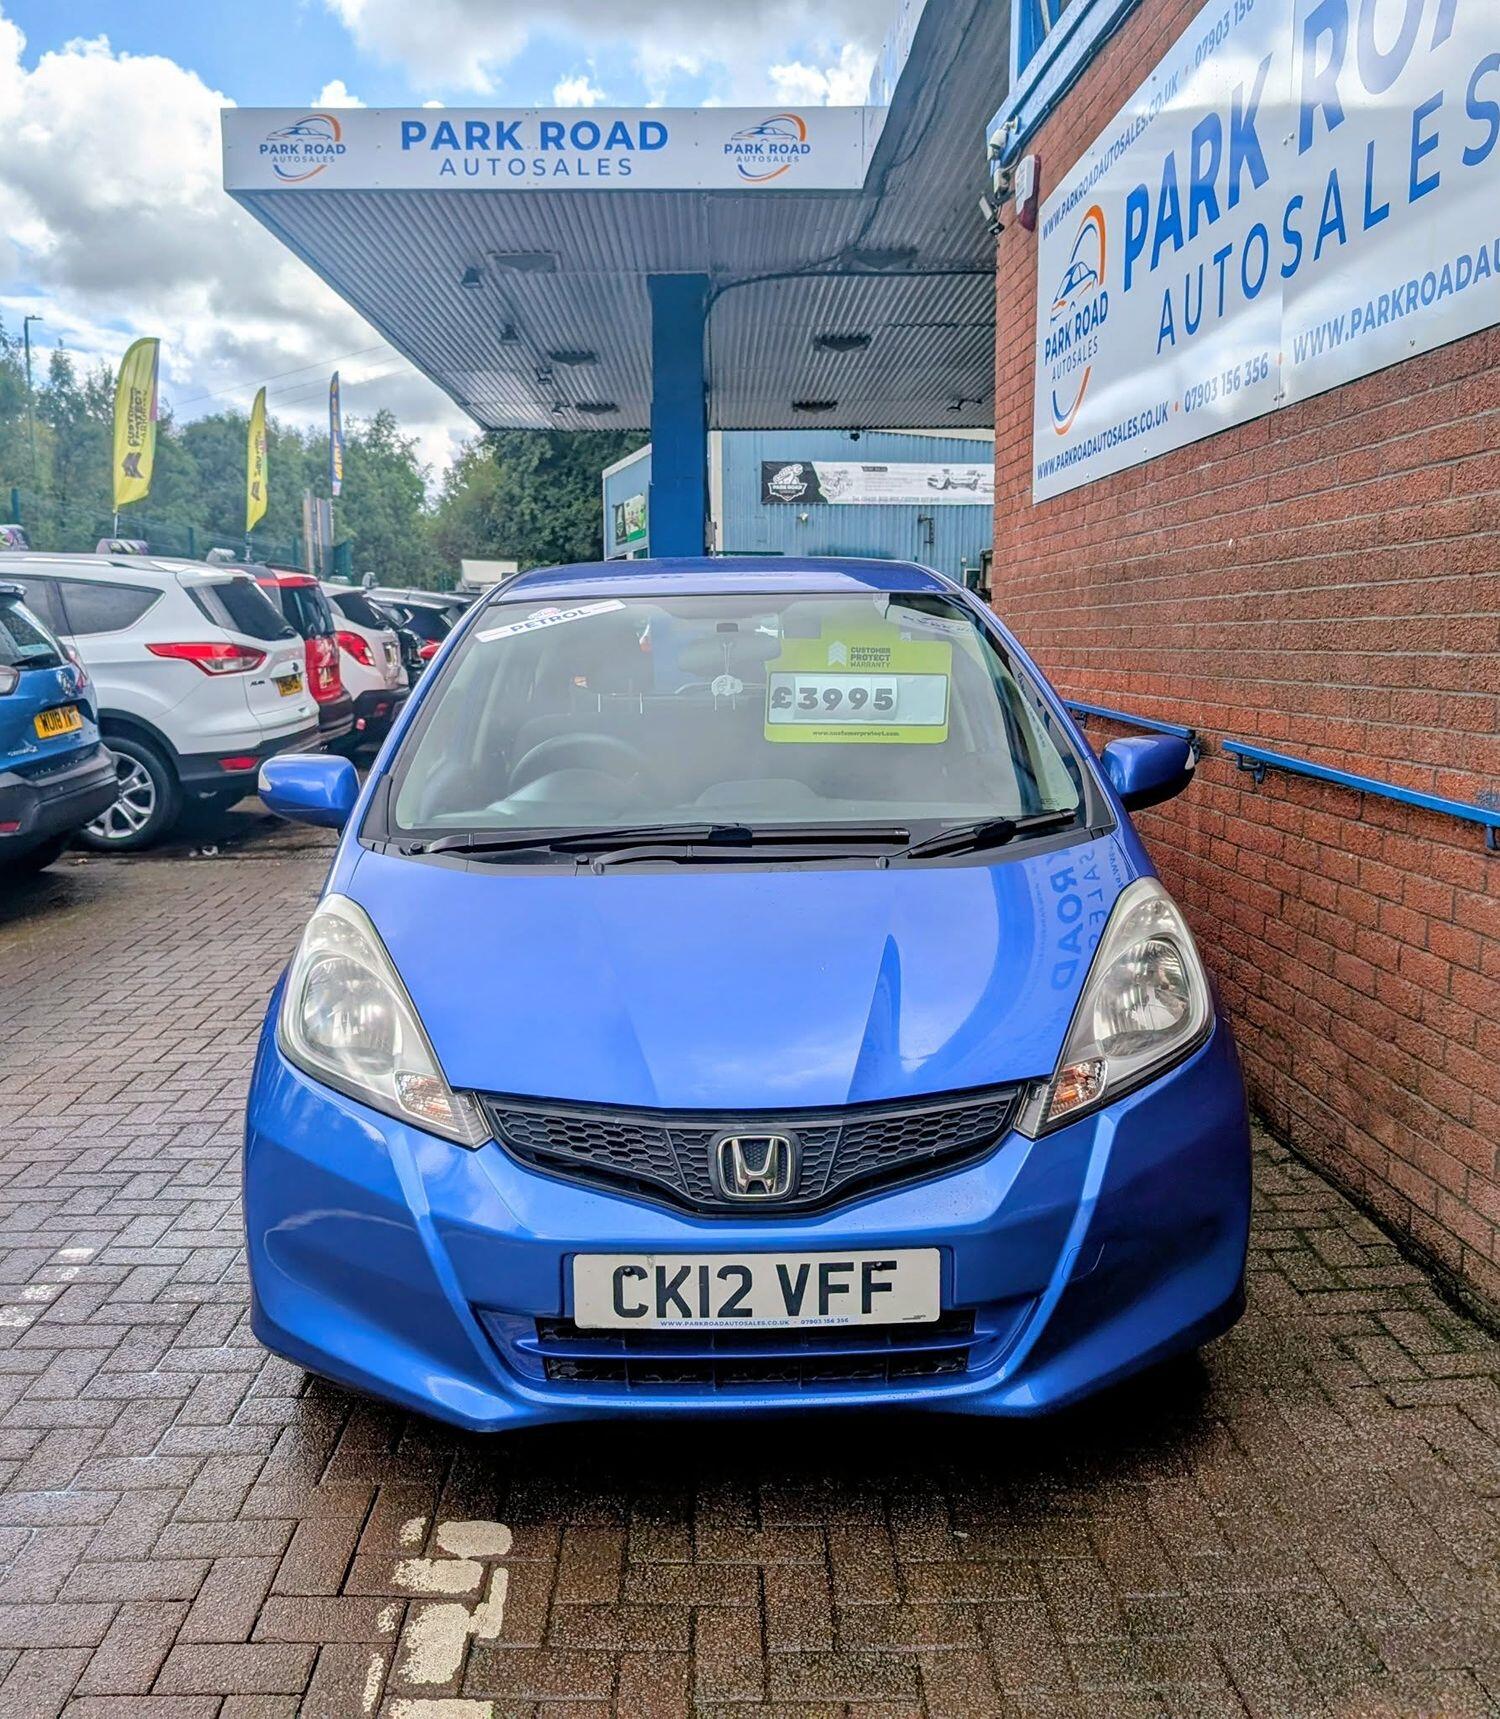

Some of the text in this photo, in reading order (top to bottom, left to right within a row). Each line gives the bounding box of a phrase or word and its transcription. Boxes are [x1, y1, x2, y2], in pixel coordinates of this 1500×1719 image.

[401, 120, 668, 151] PARK ROAD
[1042, 70, 1179, 240] WWW.PARKROADAUTOSALES.CO.UK
[1195, 10, 1230, 68] 07903
[260, 144, 346, 154] PARK ROAD
[724, 143, 811, 154] PARK ROAD
[1123, 0, 1458, 292] PARK RO
[440, 158, 632, 176] AUTOSALES
[736, 155, 800, 163] AUTOSALES
[1157, 53, 1500, 354] AUTOSALES
[1045, 290, 1109, 366] PARK ROAD
[1051, 335, 1099, 384] AUTOSALES
[1037, 401, 1169, 480] WWW.PARKROADAUTOSALES.CO.UK
[1184, 377, 1218, 413] 07903
[1221, 365, 1241, 396] 156
[1244, 351, 1269, 387] 356
[509, 609, 592, 632] PETROL
[850, 646, 891, 654] CUSTOMER
[850, 654, 891, 662] PROTECT
[850, 661, 891, 669] WARRANTY
[771, 686, 894, 711] £3995
[612, 1260, 897, 1319] CK12 VFF
[660, 1319, 789, 1327] WWW.PARKROADAUTOSALES.CO.UK
